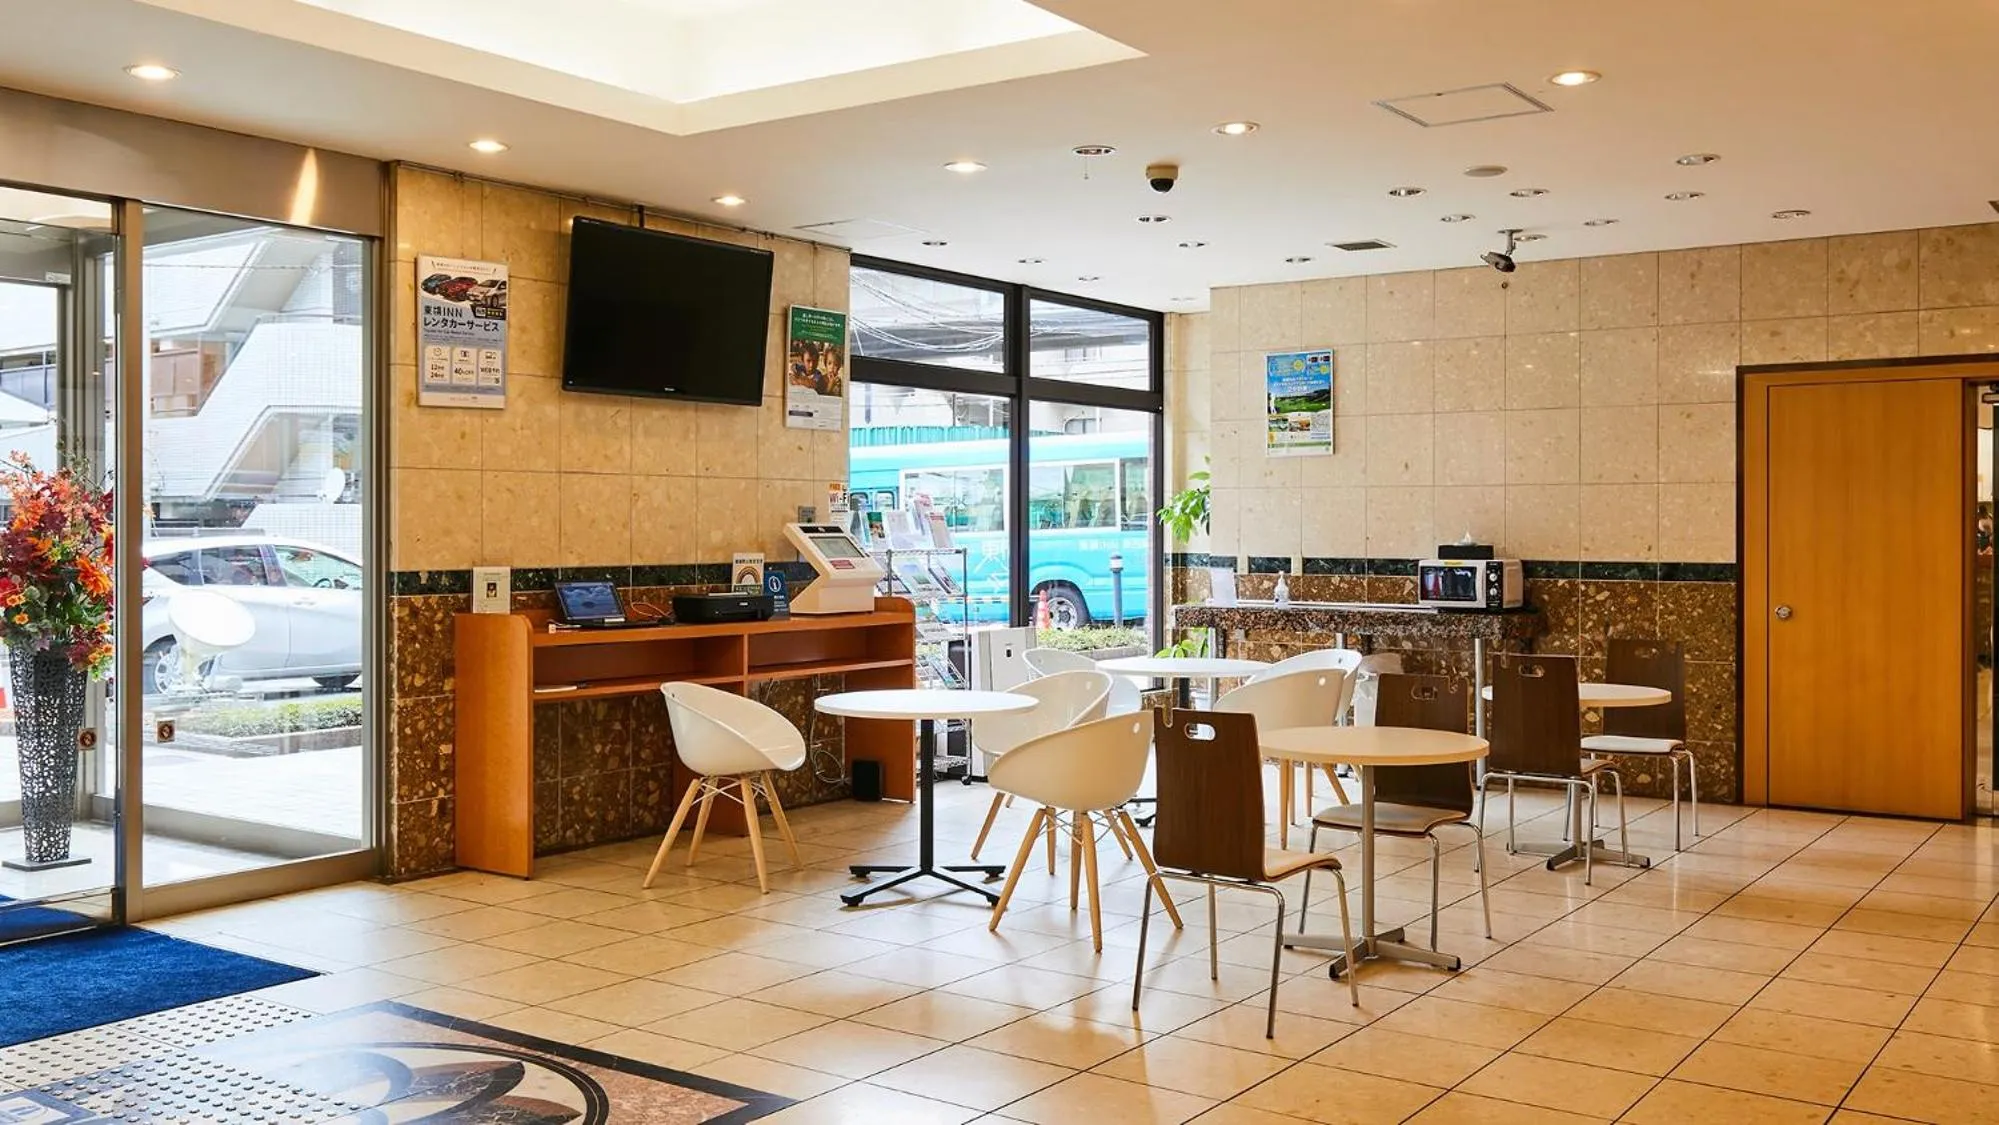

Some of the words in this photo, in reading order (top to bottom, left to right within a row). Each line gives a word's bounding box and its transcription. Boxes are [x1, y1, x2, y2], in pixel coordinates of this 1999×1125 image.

[424, 316, 500, 332] レンタカーサービス
